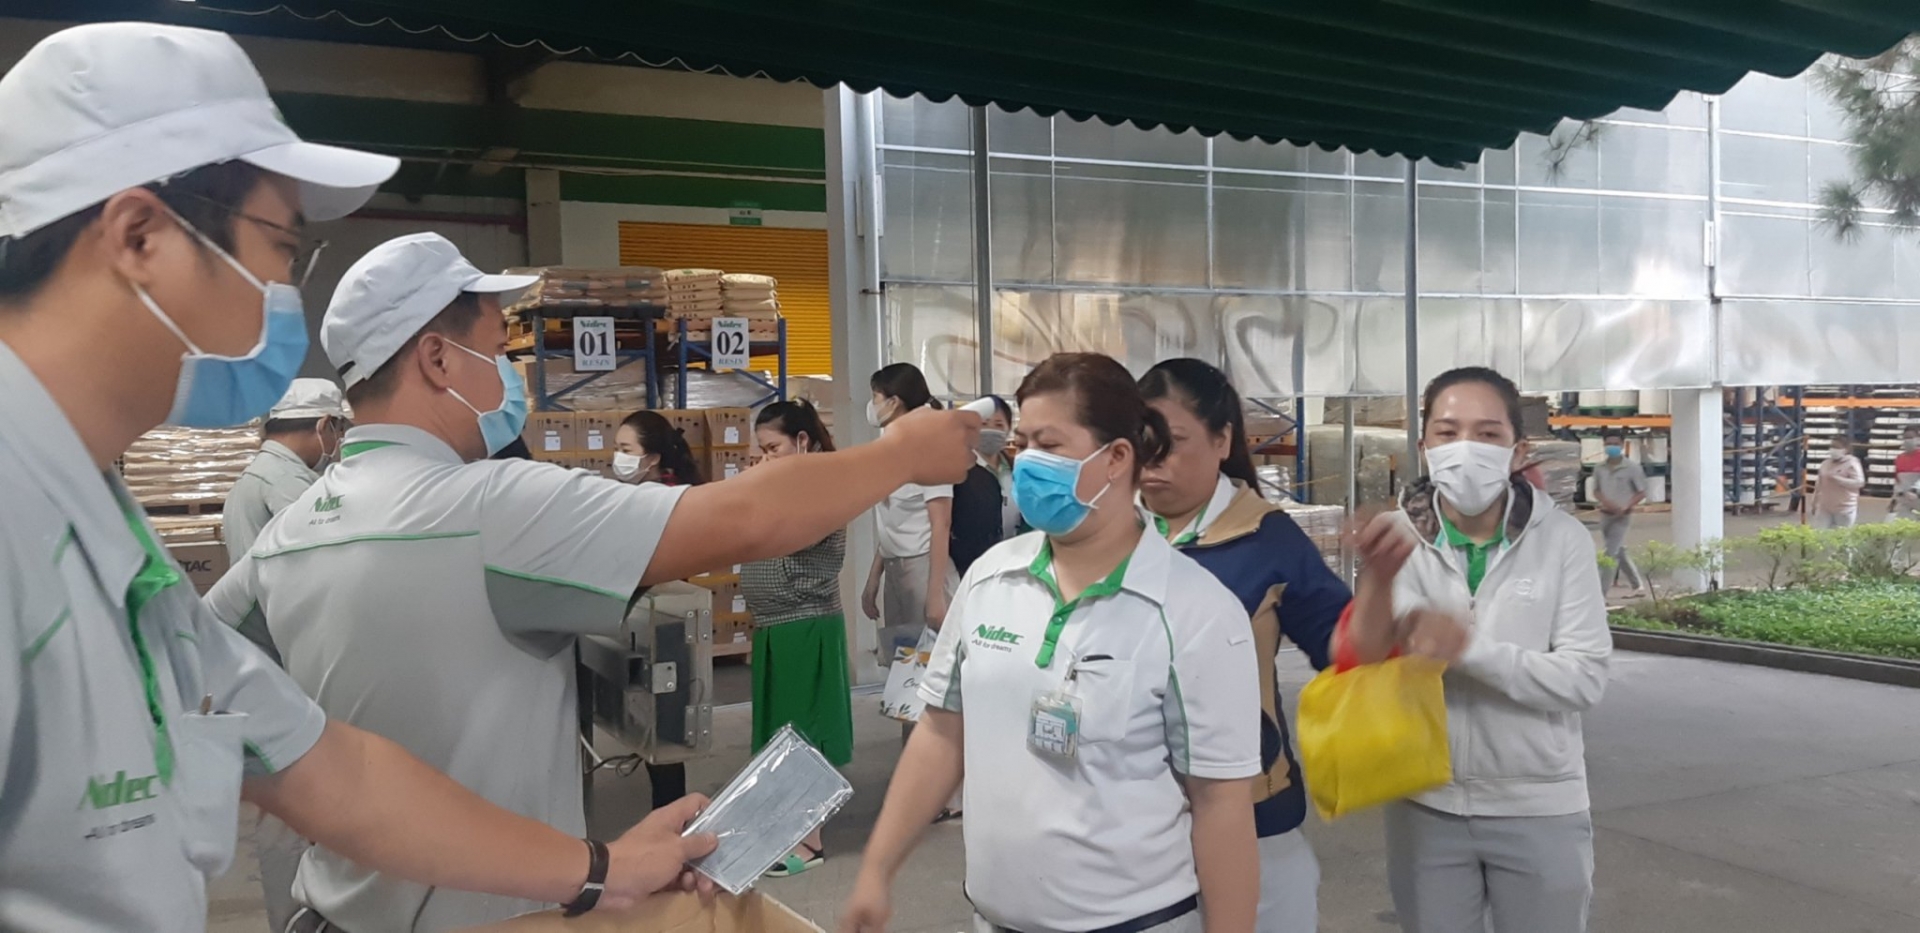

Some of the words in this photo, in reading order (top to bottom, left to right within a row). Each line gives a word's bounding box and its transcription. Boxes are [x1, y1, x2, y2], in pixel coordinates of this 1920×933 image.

[580, 331, 610, 356] 01
[717, 331, 745, 355] 02
[177, 559, 212, 572] TAC
[971, 623, 1024, 645] Nidec
[991, 643, 1012, 653] dreams
[77, 770, 159, 810] Nidec
